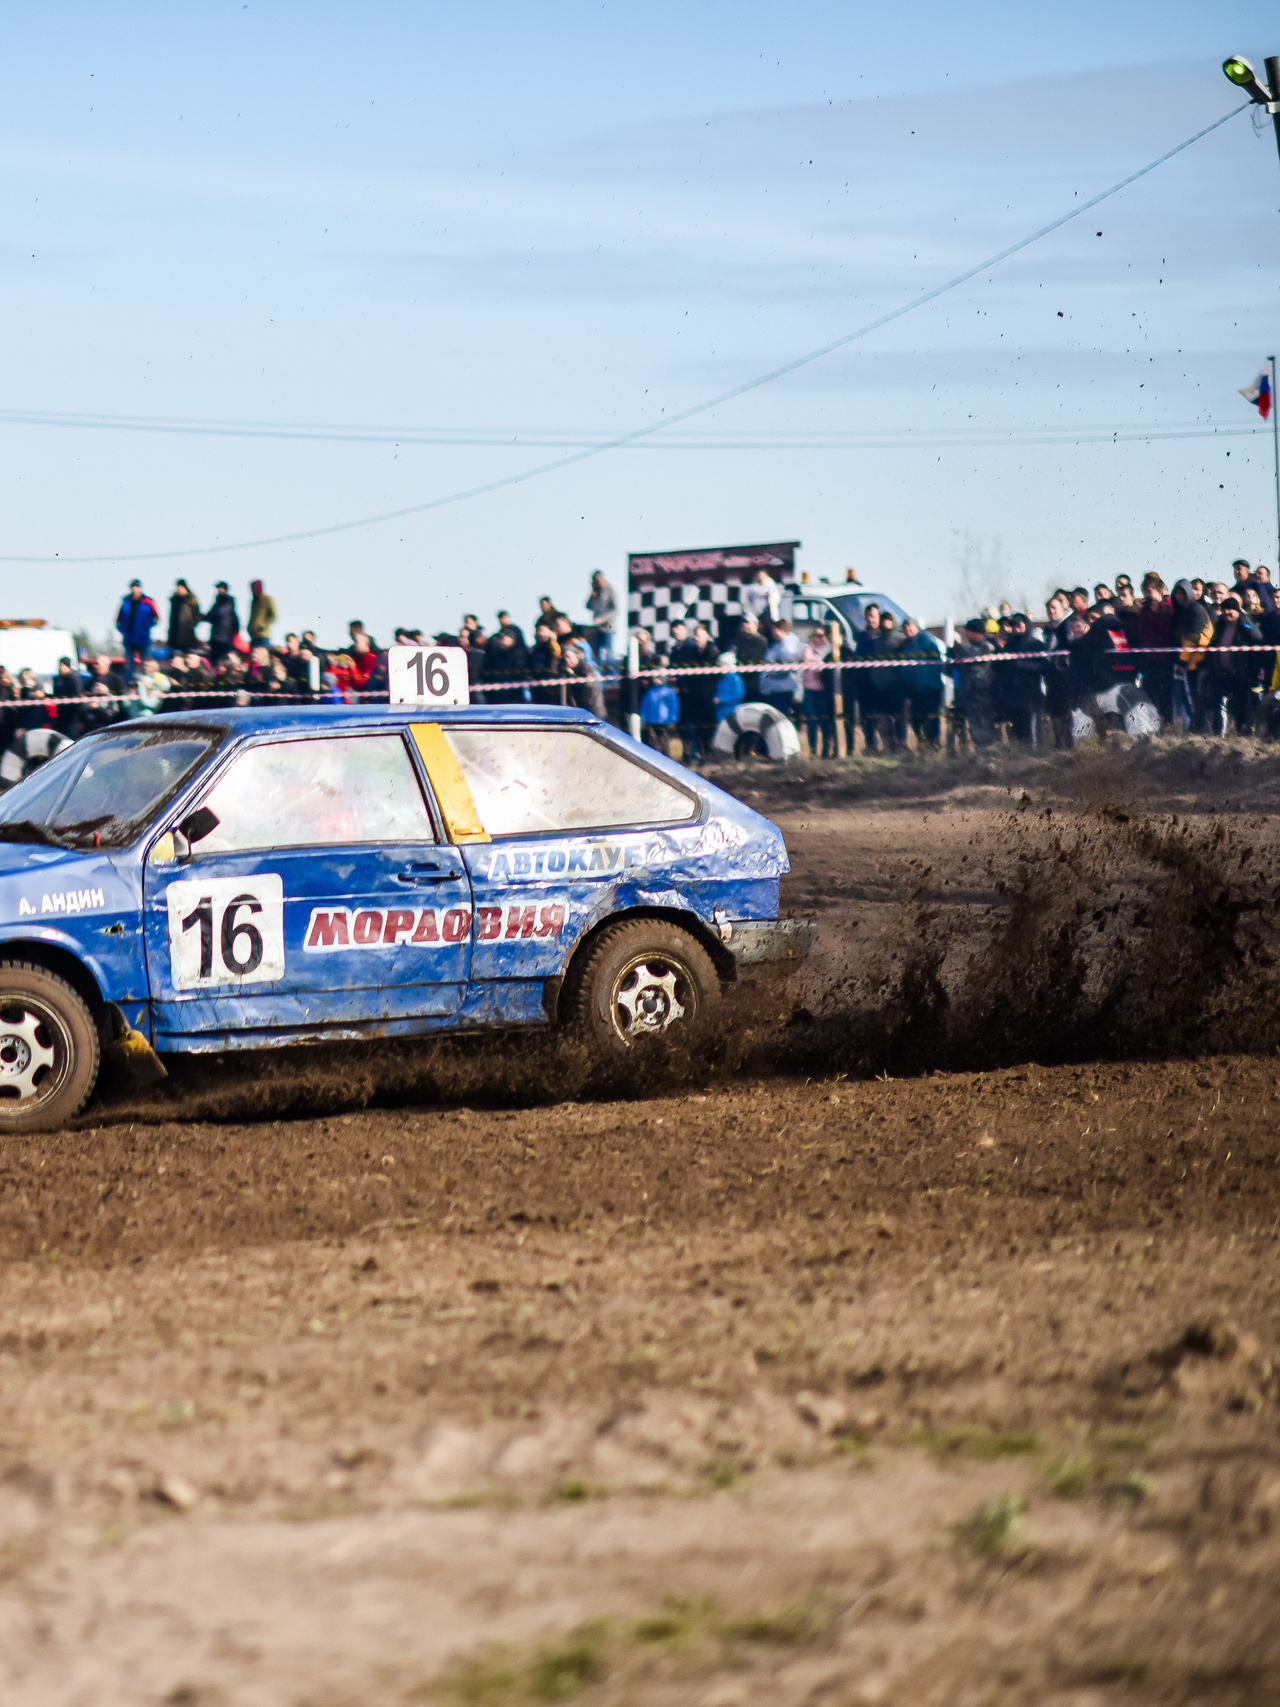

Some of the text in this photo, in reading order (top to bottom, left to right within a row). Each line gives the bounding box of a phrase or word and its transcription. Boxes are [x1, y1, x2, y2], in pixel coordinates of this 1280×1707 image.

[407, 651, 450, 697] 16
[493, 846, 645, 877] АВТОКЛУБ
[19, 888, 105, 916] А. АНДИН
[182, 893, 264, 978] 16
[308, 904, 566, 947] МОРДОВИЯ
